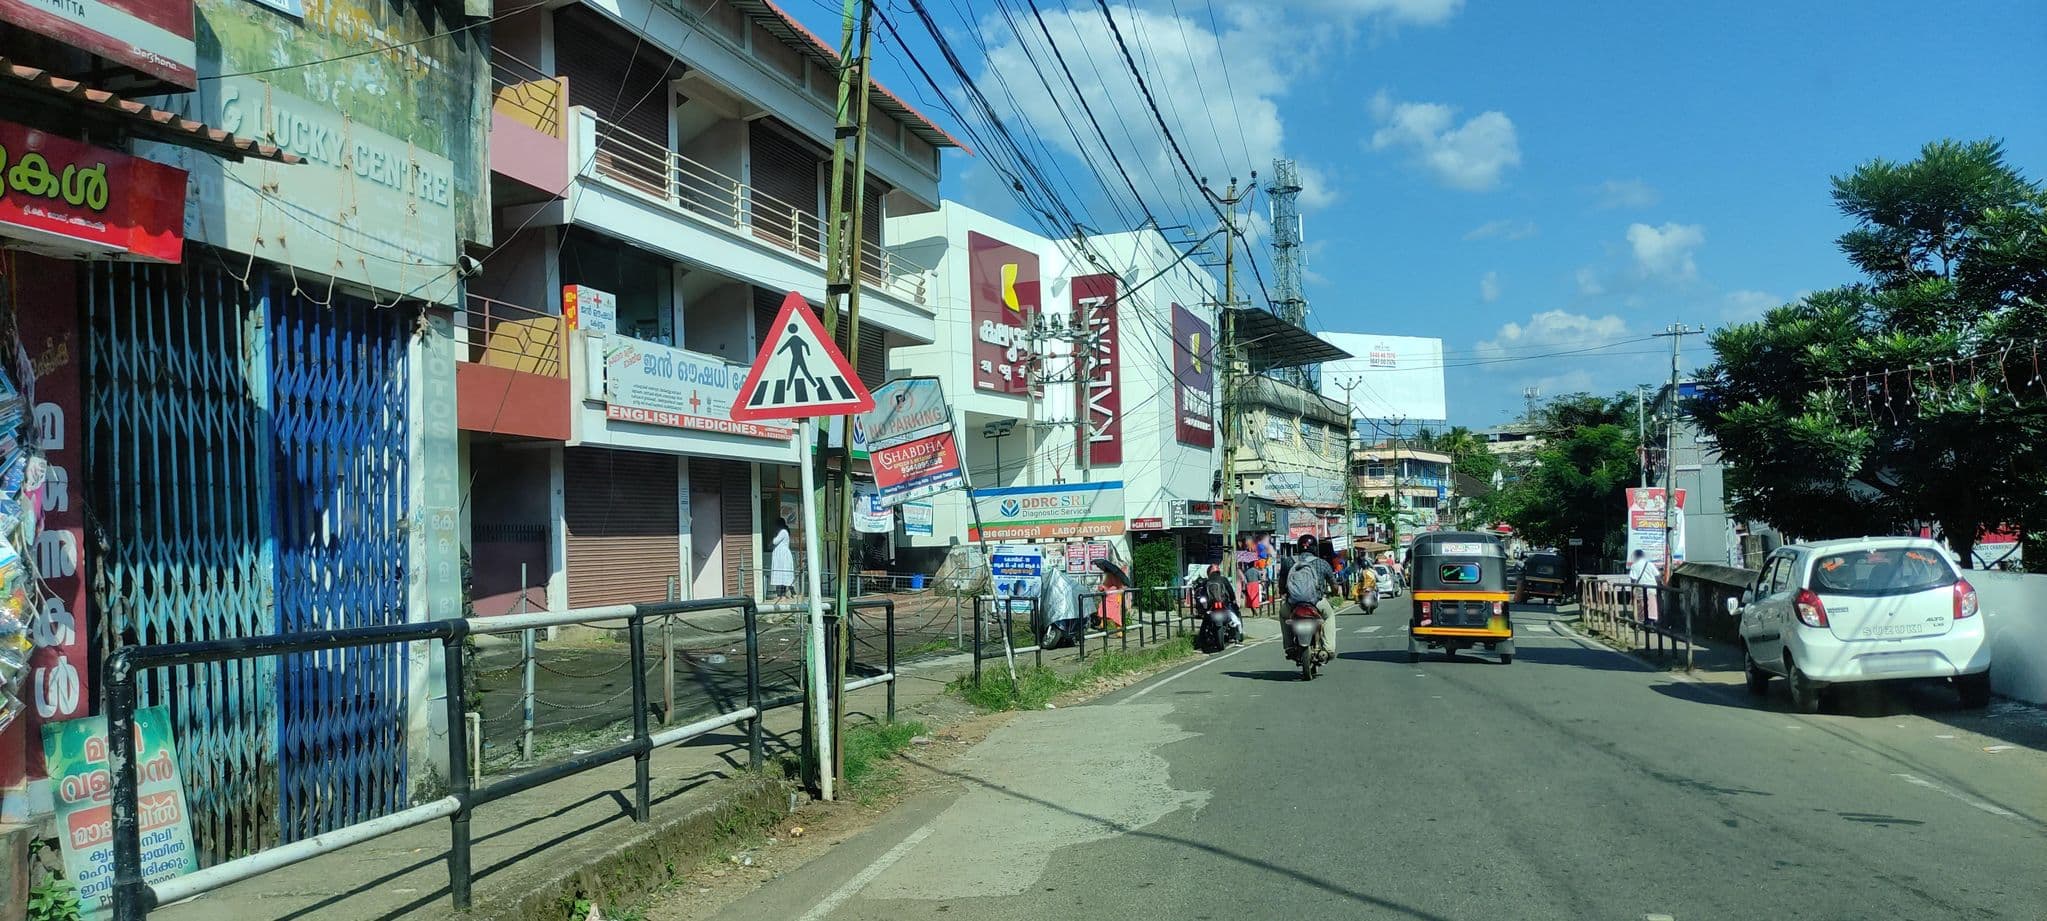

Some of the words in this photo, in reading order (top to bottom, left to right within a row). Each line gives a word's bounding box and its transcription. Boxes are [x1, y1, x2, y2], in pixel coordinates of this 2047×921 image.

[253, 101, 346, 167] LUCKY
[353, 140, 448, 206] CENTRE
[0, 143, 108, 210] കൾ
[609, 406, 679, 426] ENGLISH
[684, 416, 757, 435] MEDICINES
[869, 423, 885, 439] NO
[890, 407, 942, 433] PARKING
[884, 440, 945, 464] SHABDHA
[1022, 497, 1057, 508] DDRC
[1022, 509, 1058, 518] Diagnostic
[1052, 525, 1112, 535] LABORATORY
[1863, 624, 1922, 635] SUZUKI
[141, 857, 188, 877] ഭിക്കും
